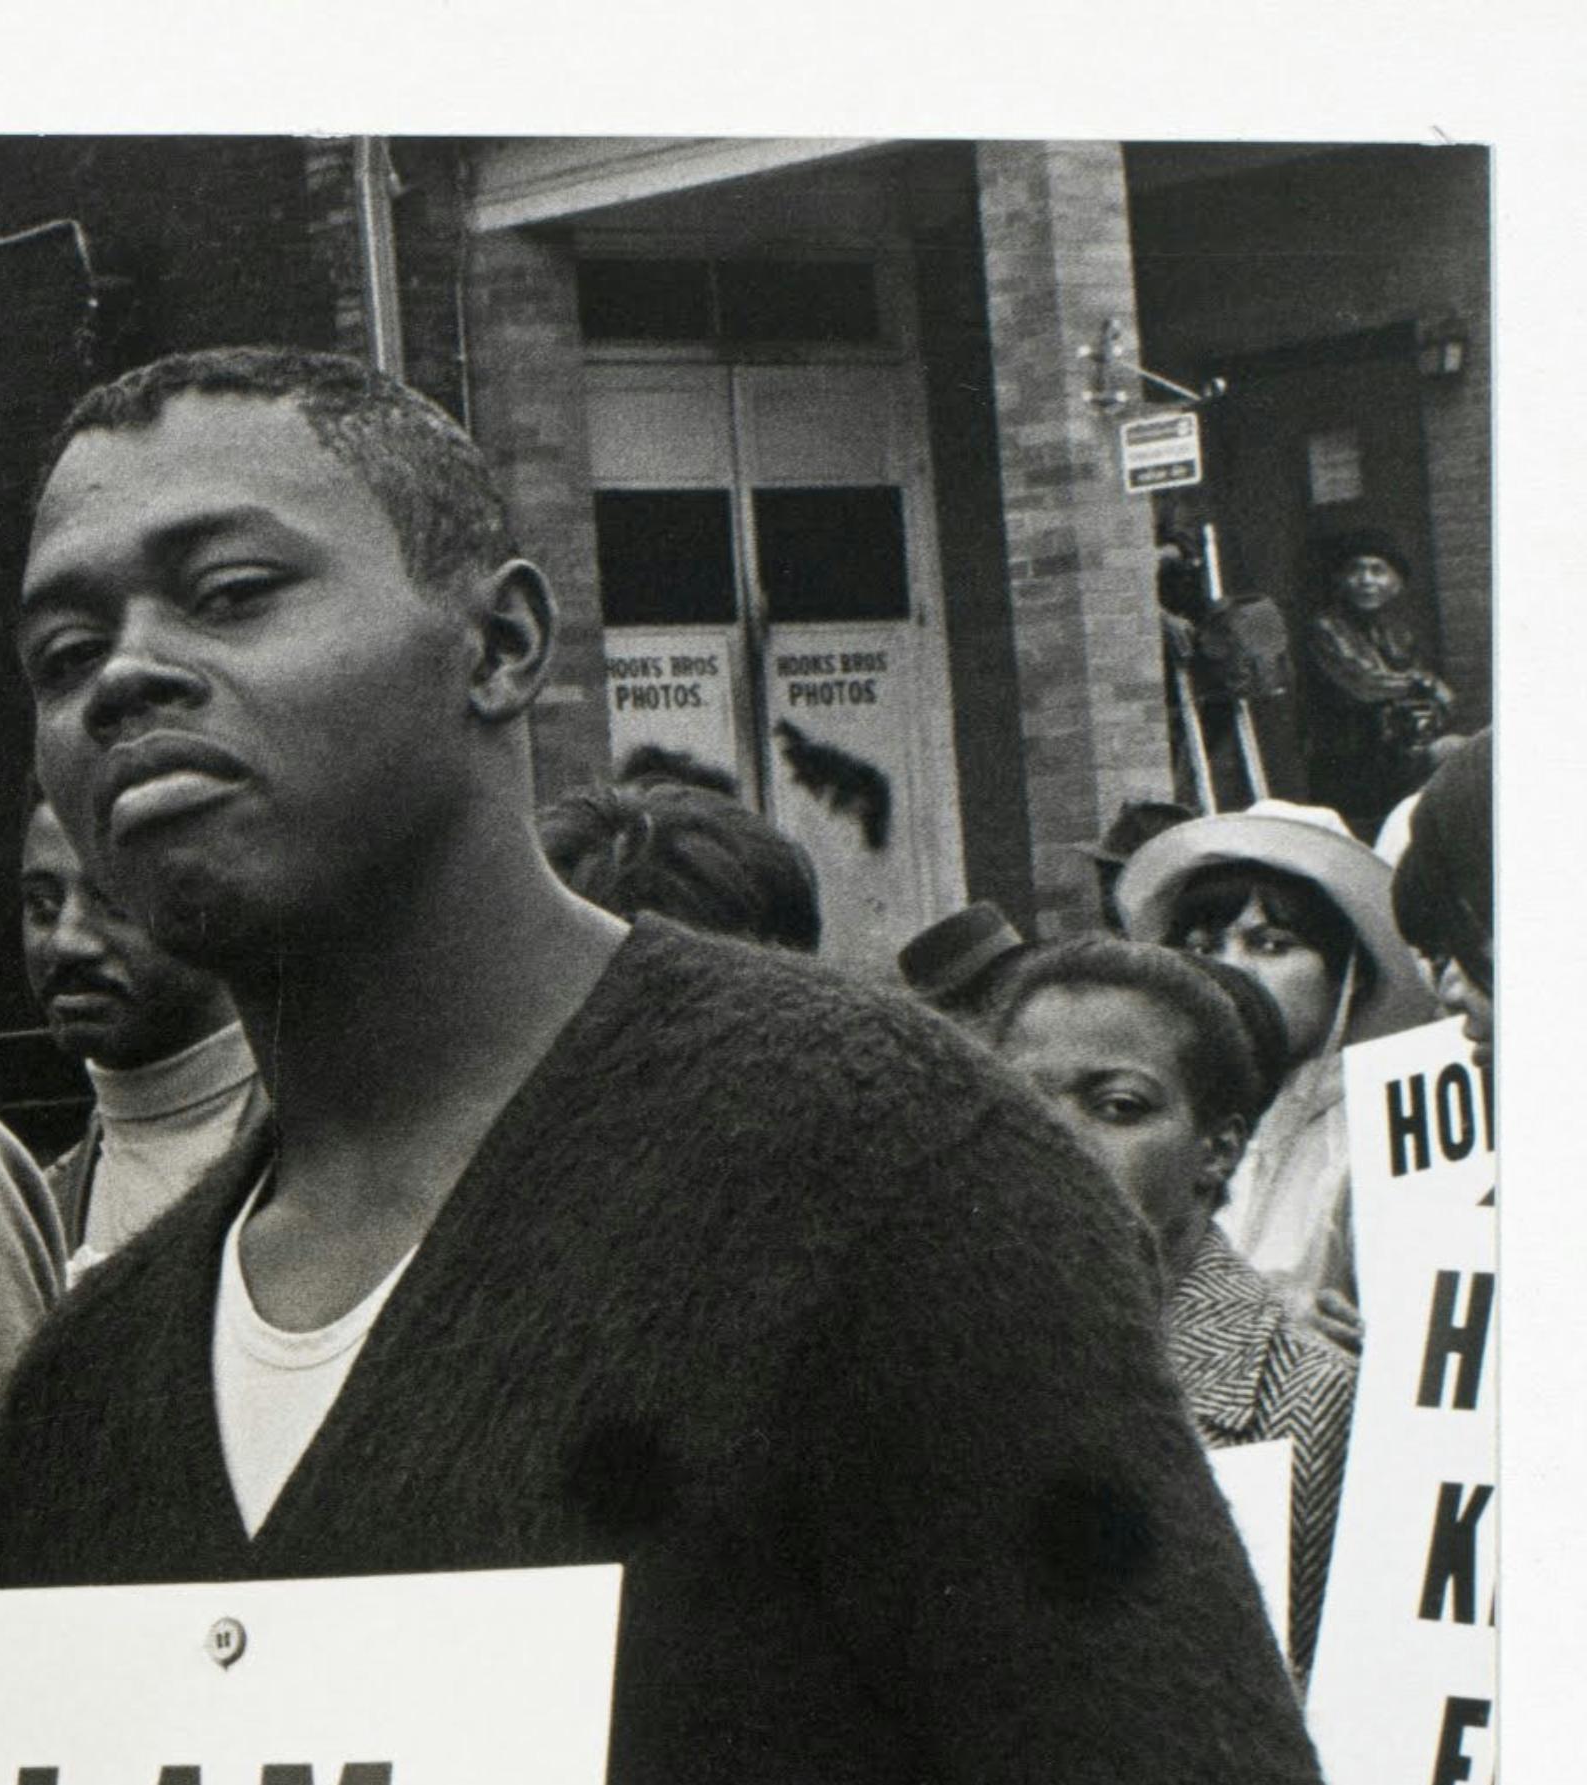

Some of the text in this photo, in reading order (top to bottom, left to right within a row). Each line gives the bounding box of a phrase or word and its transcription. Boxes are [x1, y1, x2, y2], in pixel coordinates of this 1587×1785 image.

[606, 654, 719, 679] HOOKS BROS
[778, 651, 889, 676] HOOKS BROS
[615, 684, 702, 711] PHOTOS
[788, 679, 877, 706] PHOTOS
[1418, 1481, 1495, 1627] K
